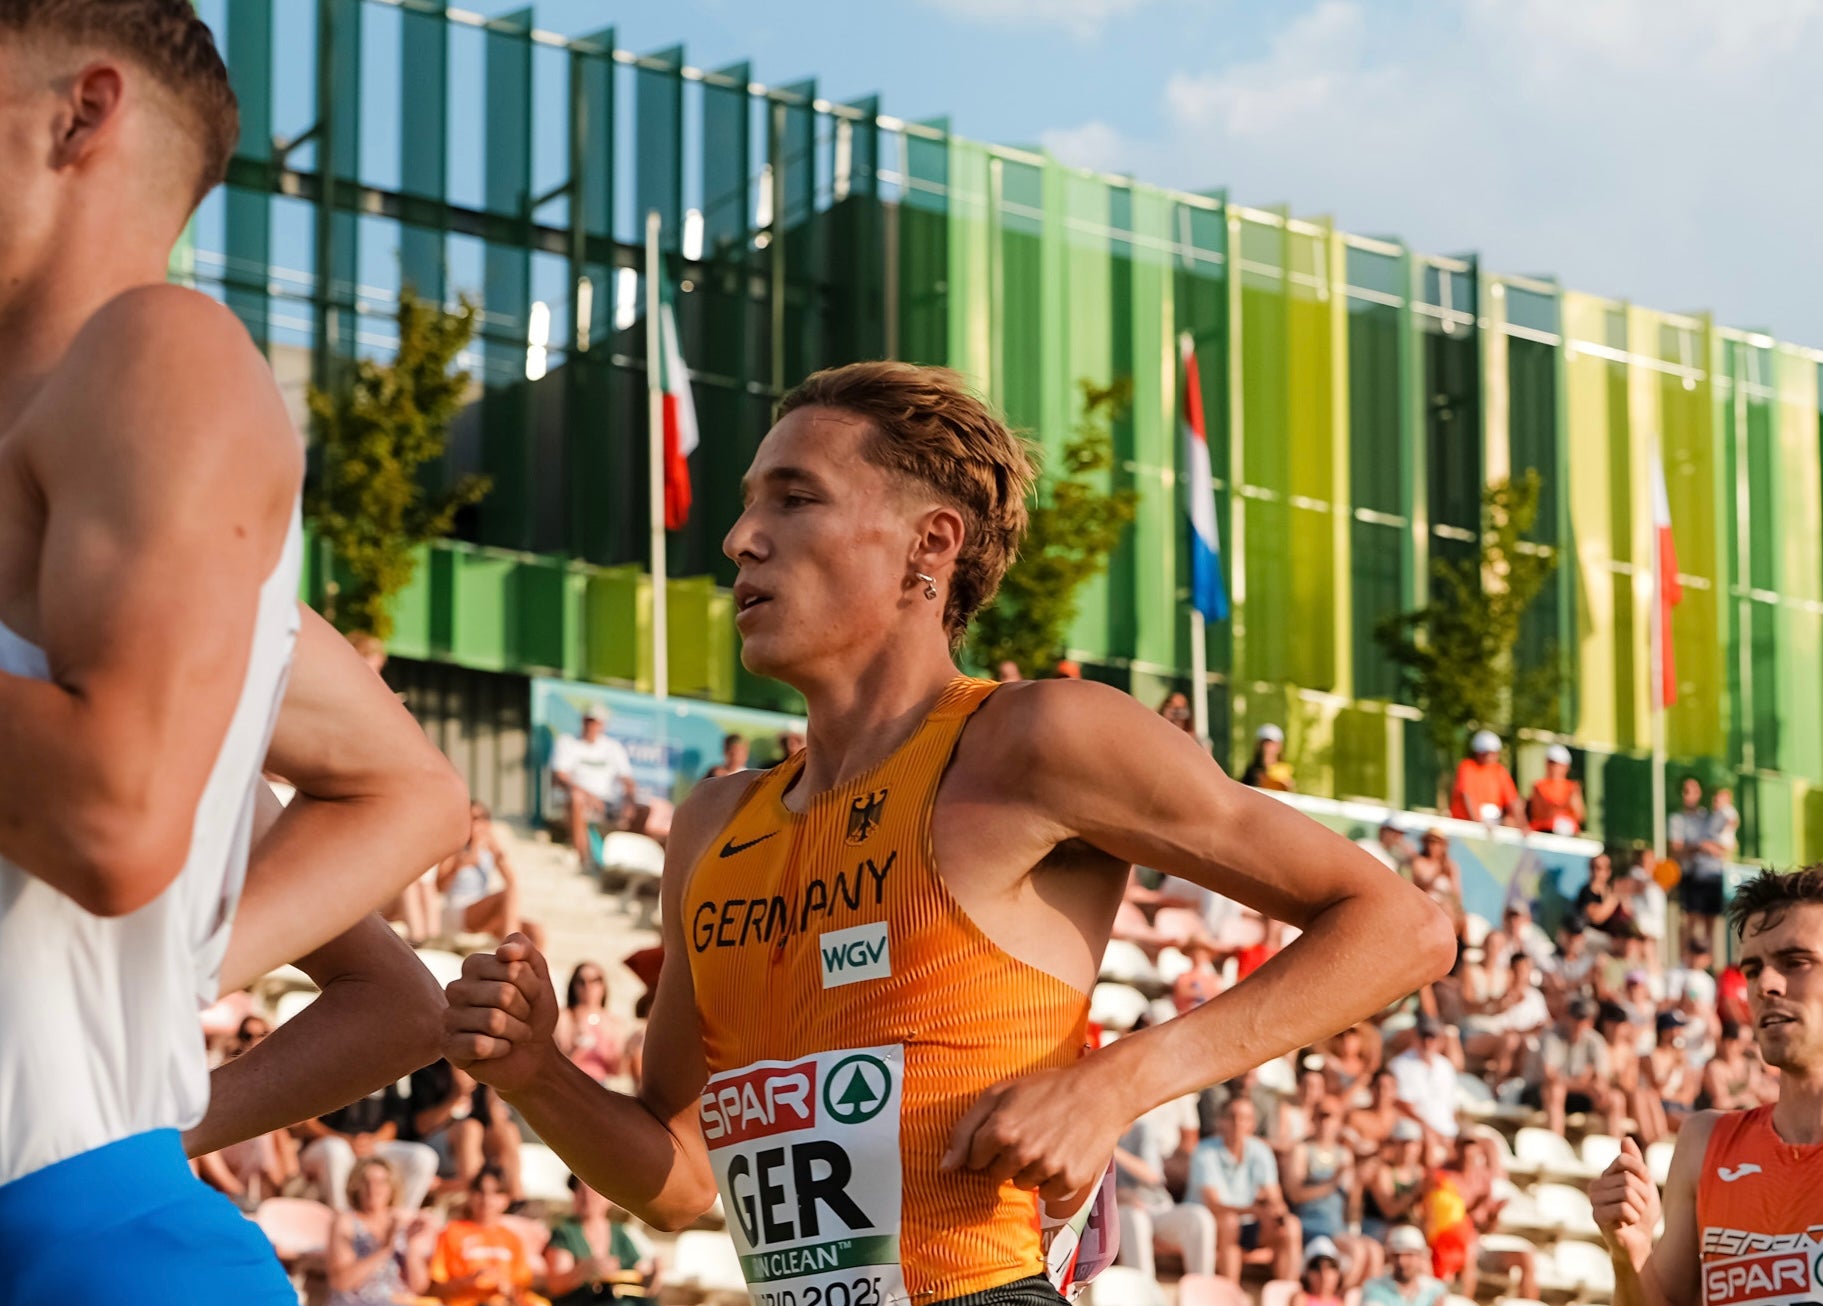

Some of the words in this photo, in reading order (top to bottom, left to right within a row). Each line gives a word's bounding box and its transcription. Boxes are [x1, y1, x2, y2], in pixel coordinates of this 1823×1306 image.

[693, 851, 896, 953] GERMANY
[822, 936, 887, 973] WGV
[700, 1072, 810, 1140] SPAR
[728, 1140, 875, 1249] GER
[1707, 1258, 1807, 1301] SPAR
